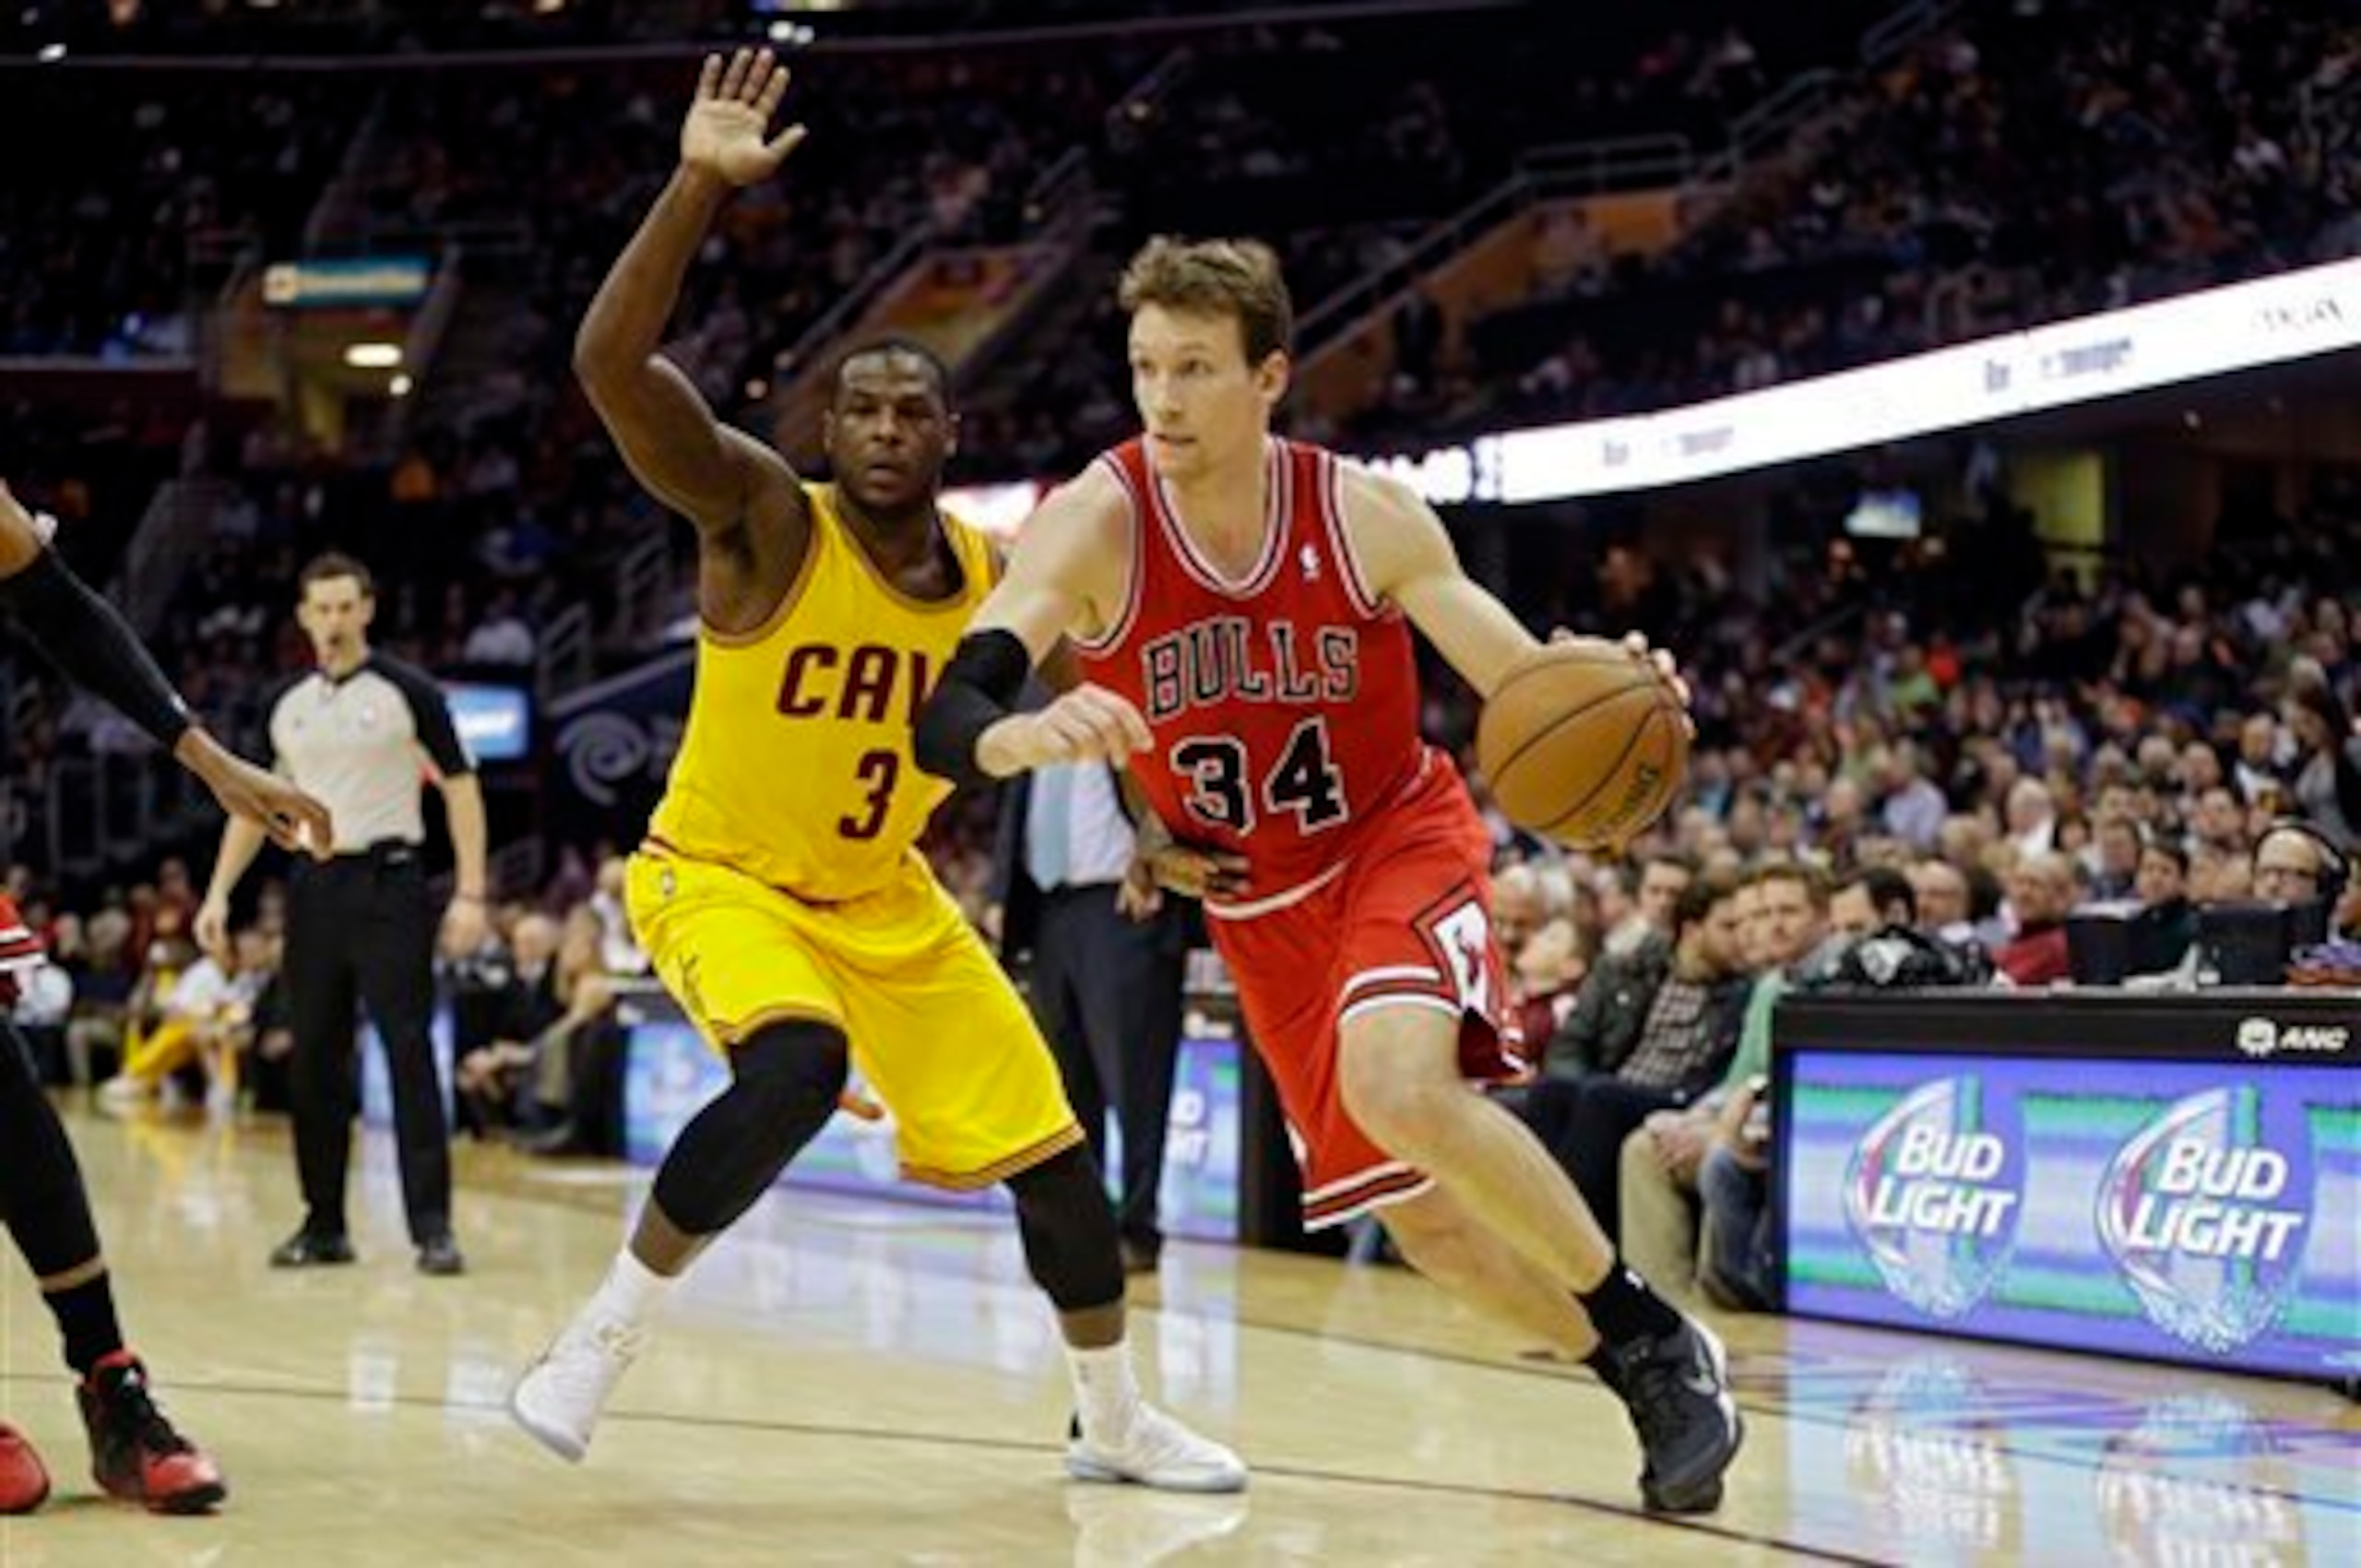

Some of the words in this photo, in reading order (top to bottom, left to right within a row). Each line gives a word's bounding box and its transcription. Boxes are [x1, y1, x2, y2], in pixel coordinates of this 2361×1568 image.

[1143, 616, 1358, 724] BULLS
[837, 748, 899, 840] 3
[1169, 716, 1348, 837] 34
[1897, 1125, 2004, 1180] BUD
[2159, 1138, 2288, 1198] BUD
[1870, 1177, 2016, 1234] LIGHT
[2128, 1194, 2302, 1260] LIGHT
